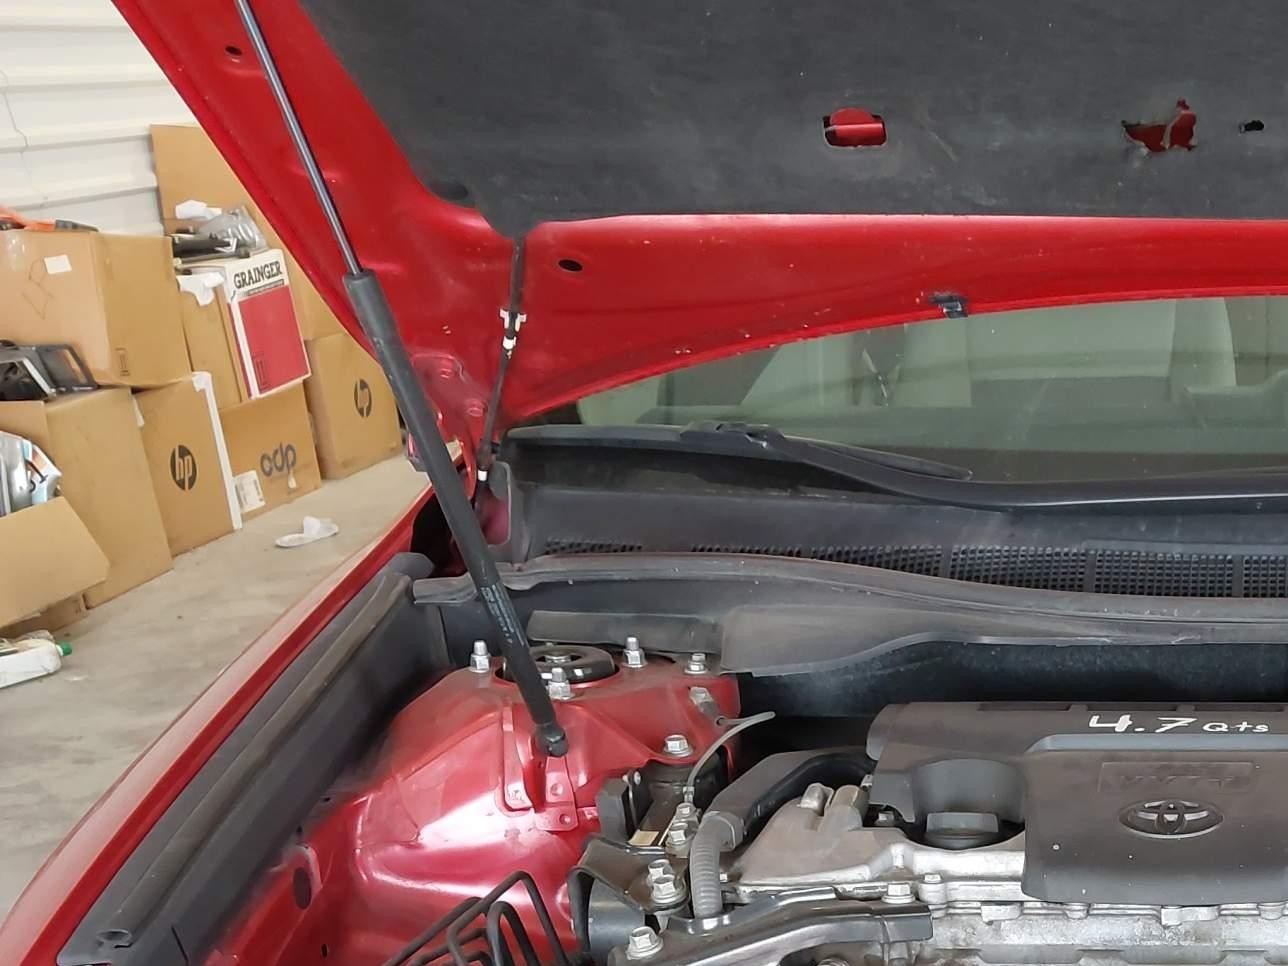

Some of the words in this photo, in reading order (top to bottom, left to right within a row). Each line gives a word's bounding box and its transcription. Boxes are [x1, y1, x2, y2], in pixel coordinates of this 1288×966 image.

[233, 260, 283, 289] GRAINGER
[170, 444, 197, 490] hp
[1088, 714, 1198, 733] 4.7
